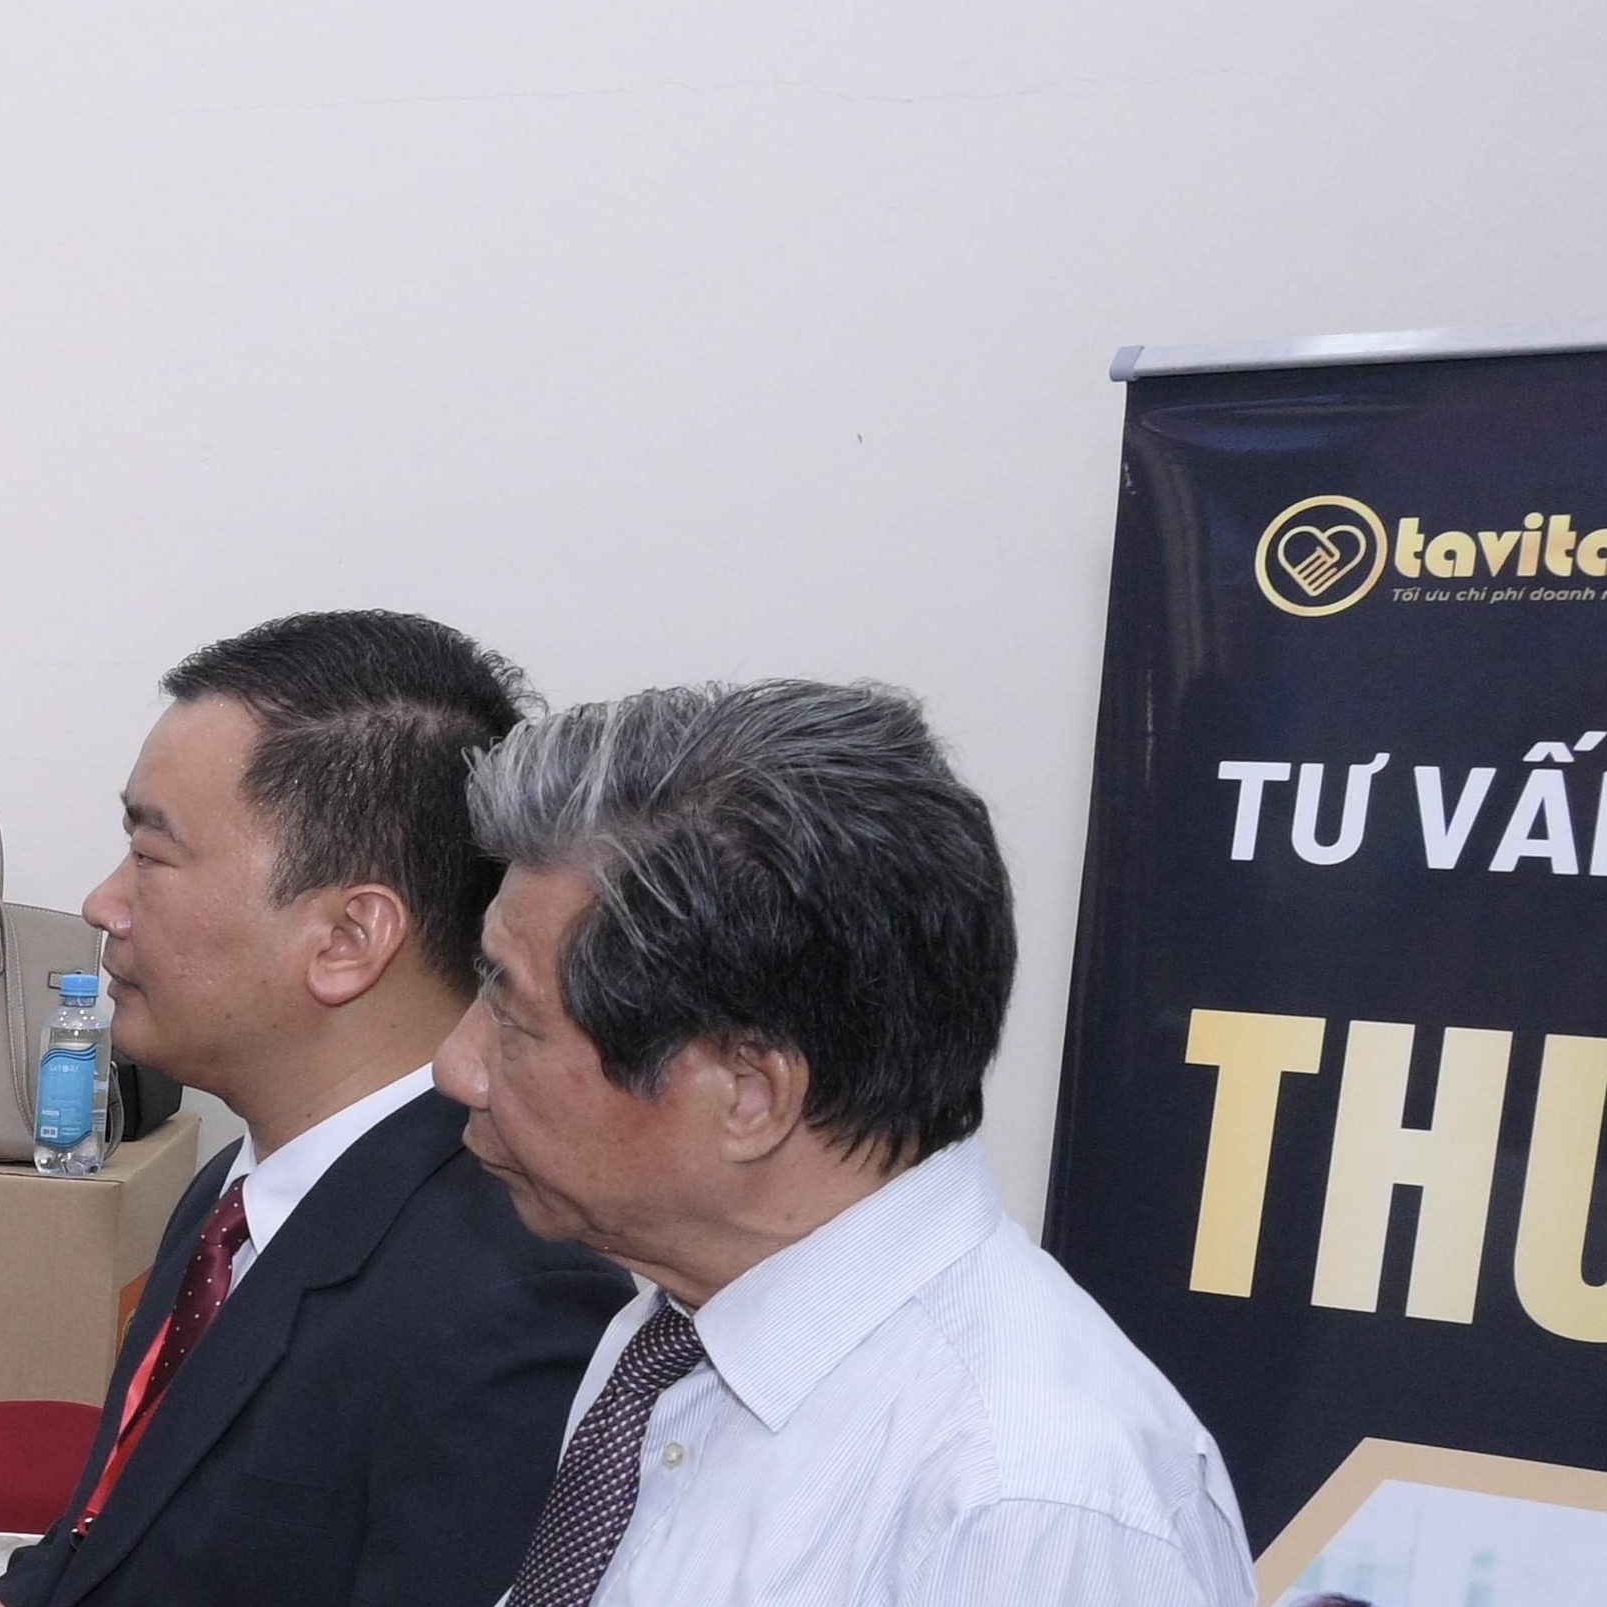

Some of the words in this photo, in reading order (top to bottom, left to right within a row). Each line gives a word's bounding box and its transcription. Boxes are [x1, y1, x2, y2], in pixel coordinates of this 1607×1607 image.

[1490, 586, 1526, 604] phí
[1530, 586, 1596, 601] doanh
[1216, 752, 1390, 866] TƯ
